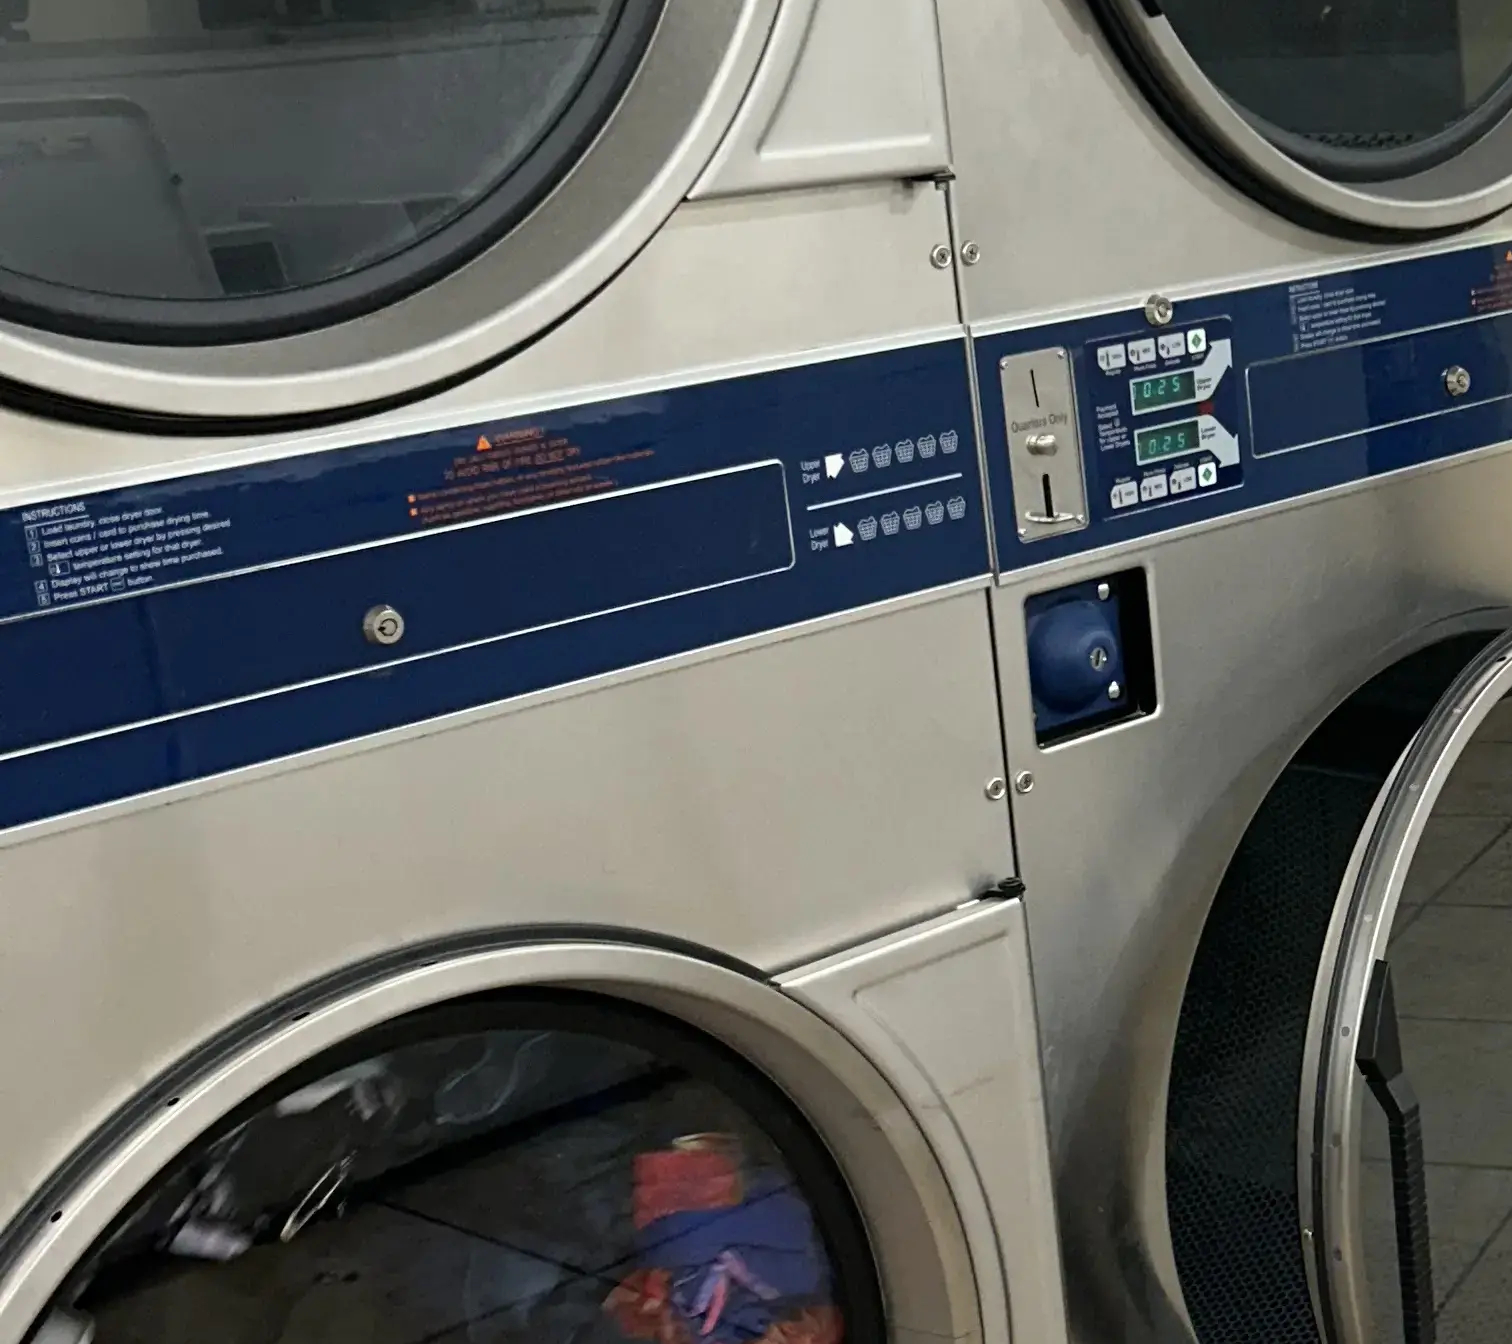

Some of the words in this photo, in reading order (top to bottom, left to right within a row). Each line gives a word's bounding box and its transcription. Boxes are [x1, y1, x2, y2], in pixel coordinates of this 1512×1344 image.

[1011, 416, 1047, 433] Quarters
[1050, 412, 1068, 425] Only
[802, 472, 820, 484] Dryer
[21, 501, 86, 523] INSTRUCTIONS
[811, 539, 829, 551] Dryer
